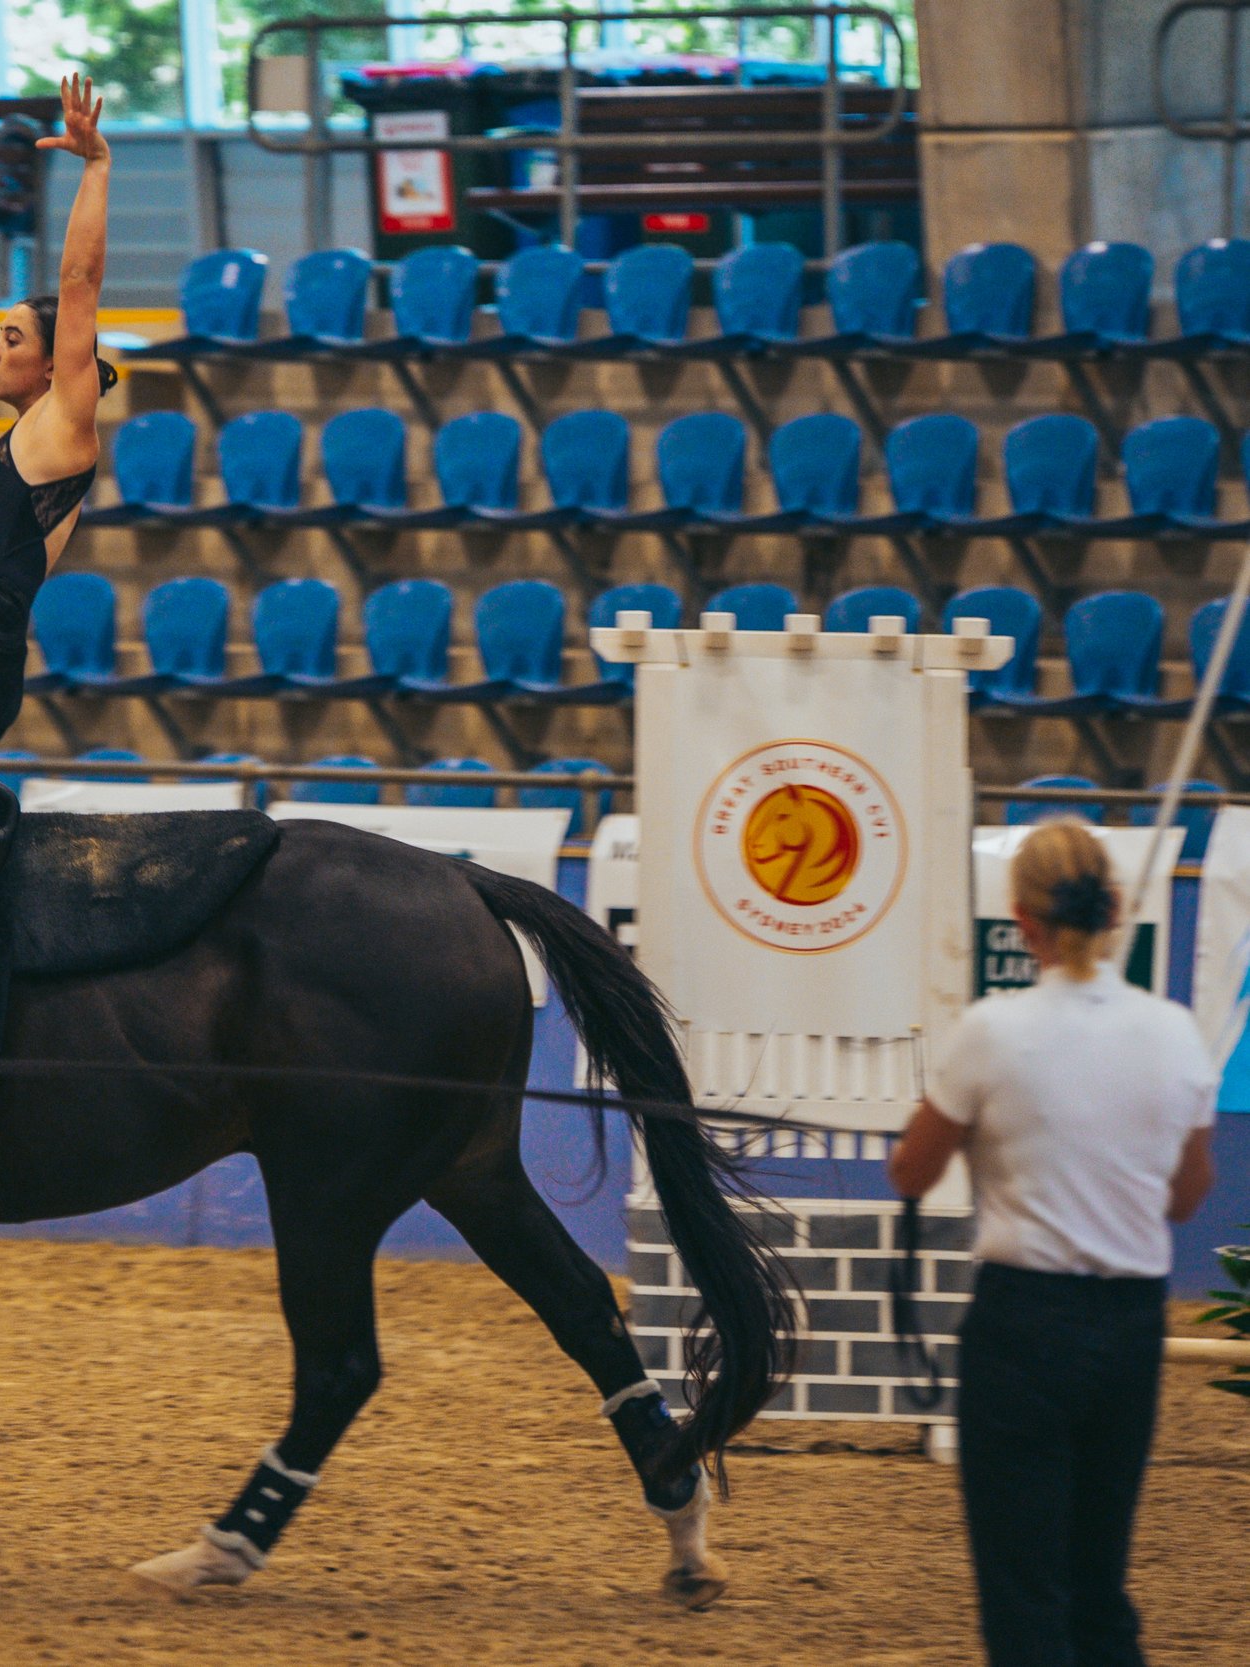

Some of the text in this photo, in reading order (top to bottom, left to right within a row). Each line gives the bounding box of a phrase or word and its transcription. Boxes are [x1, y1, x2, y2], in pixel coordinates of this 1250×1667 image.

[712, 776, 753, 835] GREAT
[760, 759, 868, 794] SOUTHERN
[735, 899, 867, 935] SYDNEY 2024
